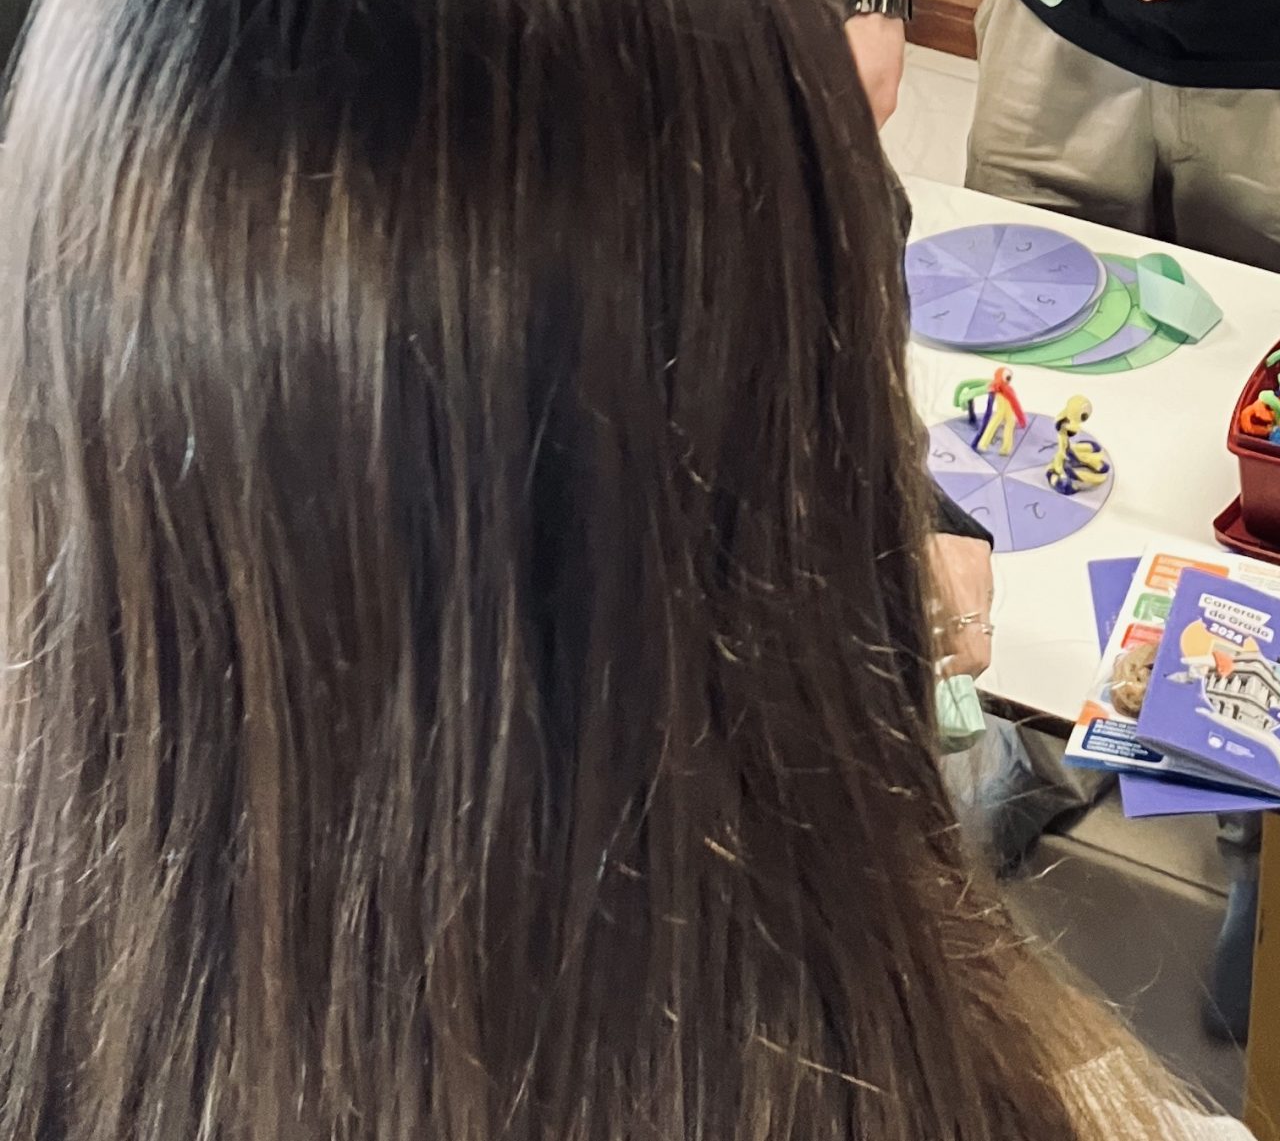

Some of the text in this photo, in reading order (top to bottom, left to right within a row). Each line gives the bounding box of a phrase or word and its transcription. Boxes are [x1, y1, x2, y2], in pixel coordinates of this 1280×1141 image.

[1203, 596, 1262, 622] Carreras
[1209, 610, 1269, 638] de Grado
[1209, 622, 1243, 644] 2024
